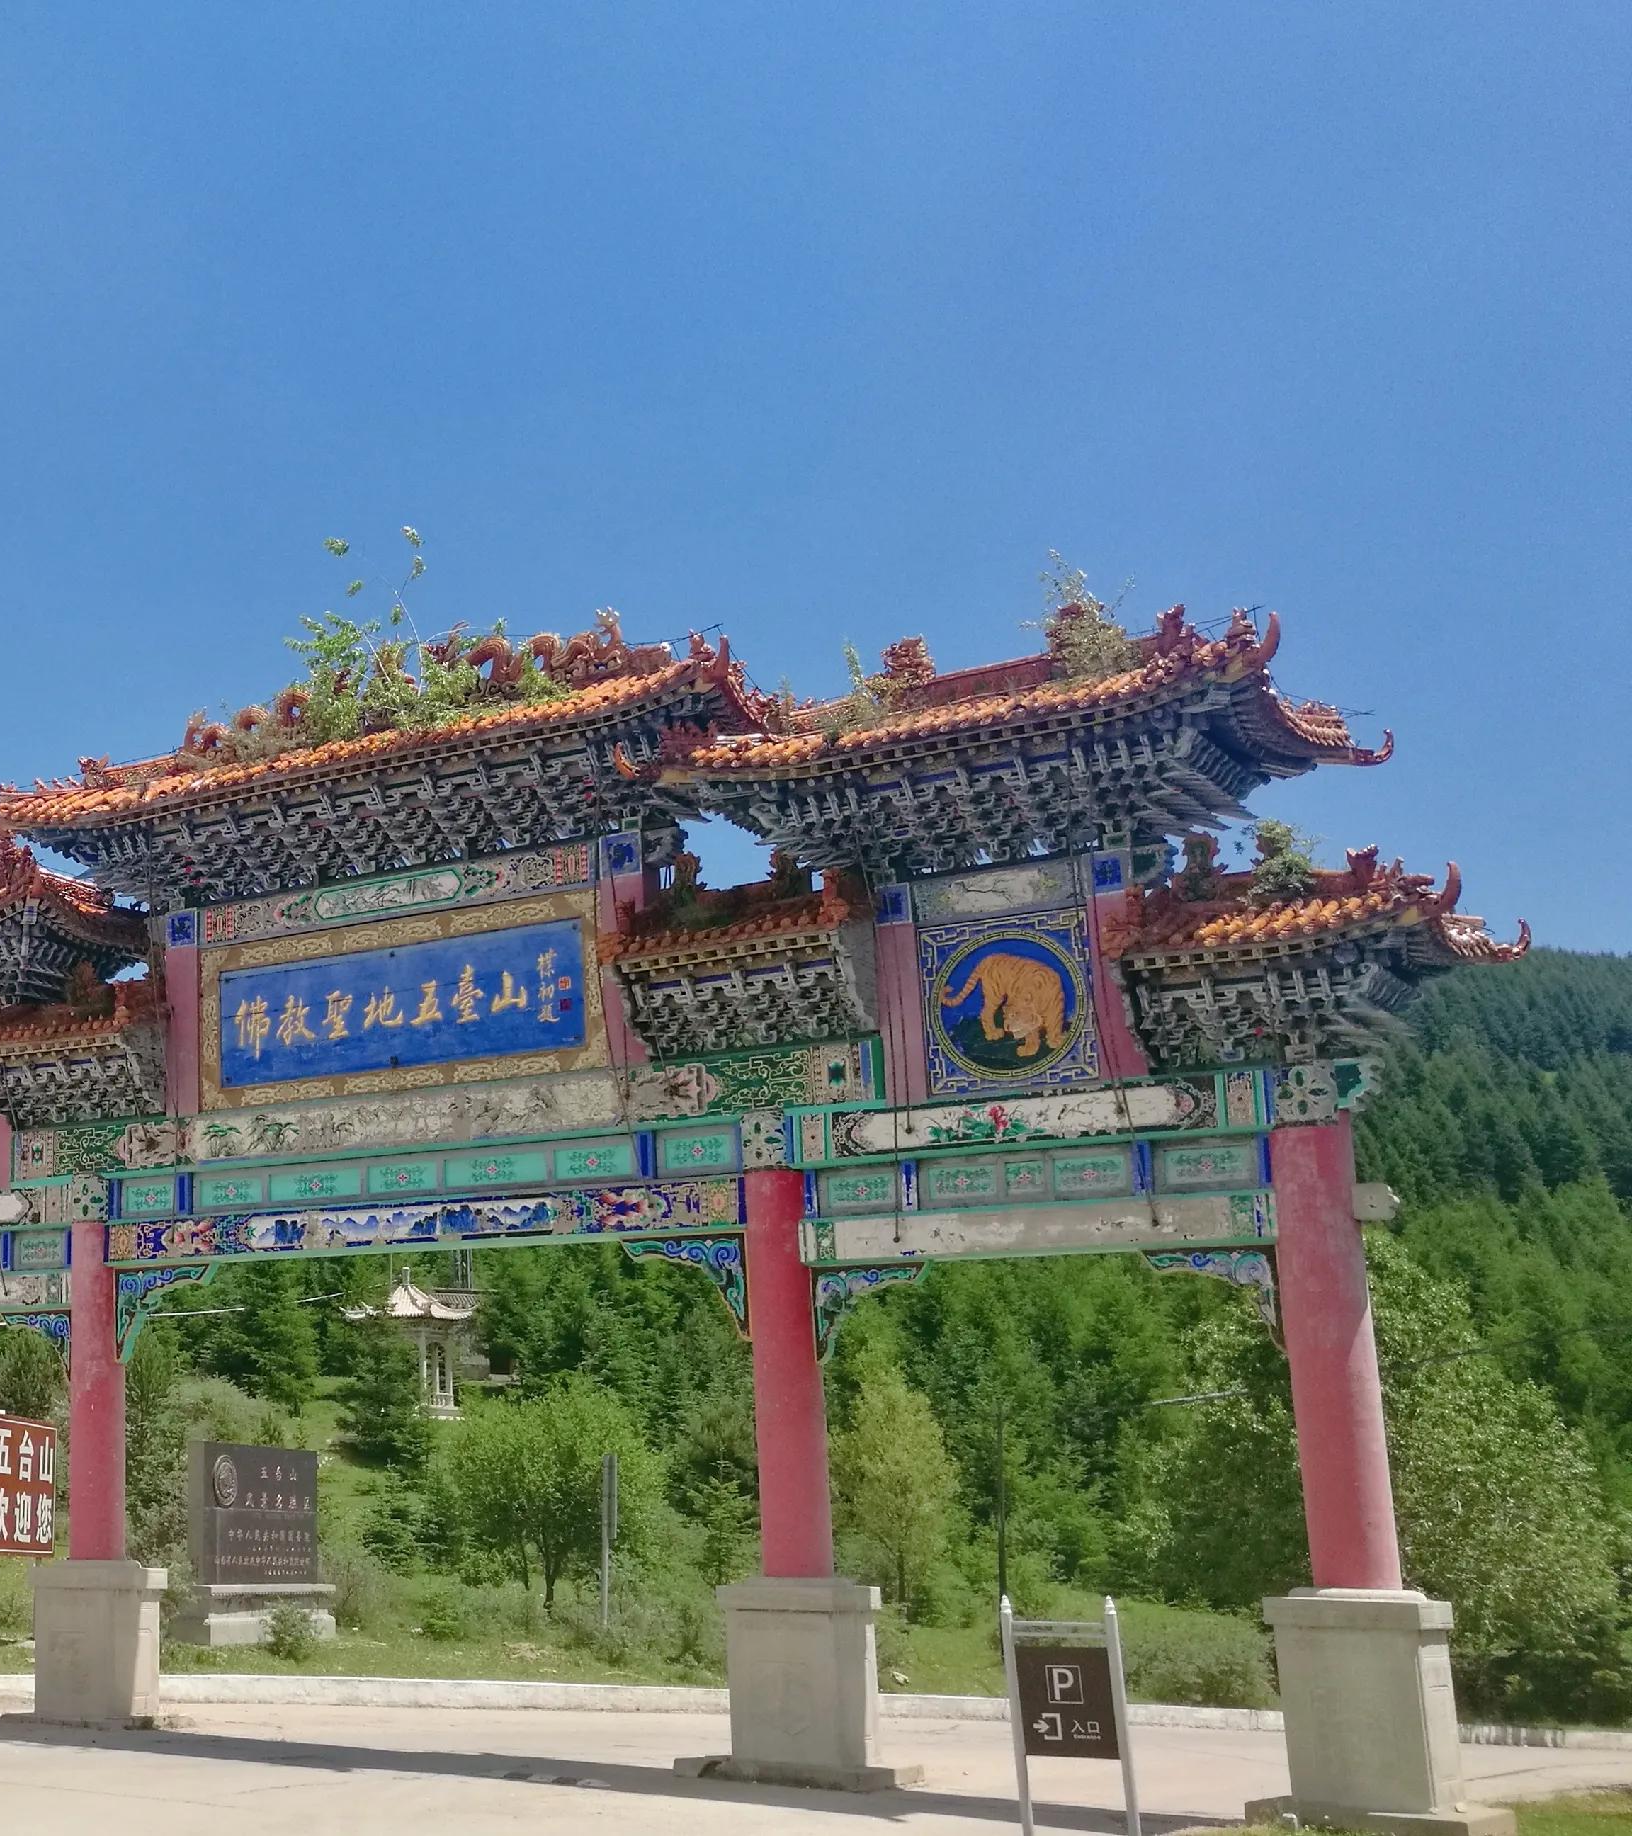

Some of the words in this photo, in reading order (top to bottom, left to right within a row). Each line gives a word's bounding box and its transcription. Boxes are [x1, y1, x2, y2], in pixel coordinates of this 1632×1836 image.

[234, 963, 527, 1061] 佛教聖地五臺山
[260, 1466, 297, 1481] 五台山
[1052, 1668, 1074, 1701] P
[1071, 1720, 1100, 1734] 入口
